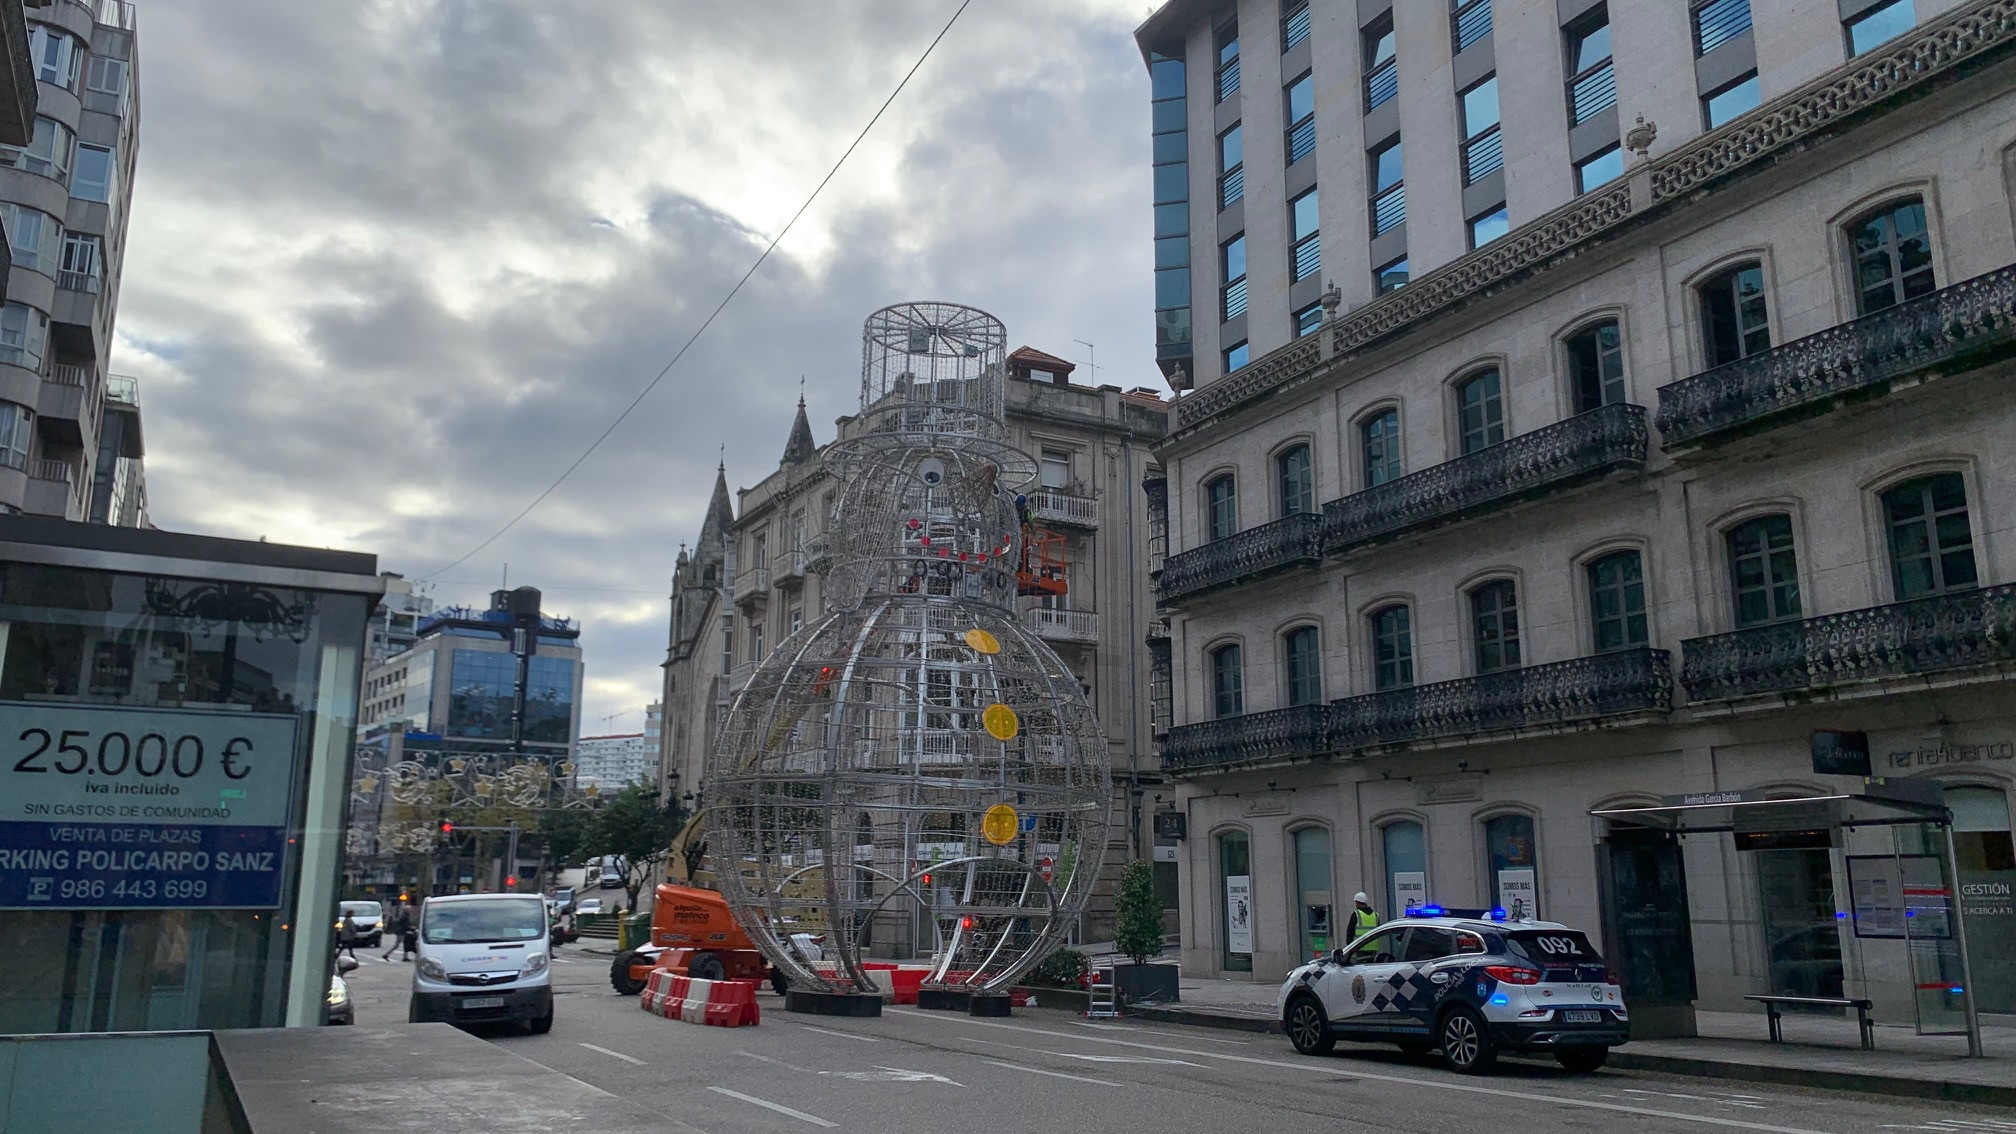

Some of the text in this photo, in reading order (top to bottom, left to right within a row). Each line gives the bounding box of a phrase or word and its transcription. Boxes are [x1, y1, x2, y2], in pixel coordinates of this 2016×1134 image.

[12, 727, 254, 780] 25.000 €
[85, 780, 180, 797] iva incluido
[1684, 795, 1704, 805] Avenida
[24, 803, 231, 819] SIN GASTOS DE COMUNIDAD
[1164, 818, 1178, 829] 24
[50, 827, 202, 844] VENTA DE PLAZAS
[76, 850, 210, 871] POLICARPO
[215, 852, 274, 872] SANZ
[61, 879, 105, 899] 986
[112, 879, 157, 899] 443
[164, 879, 208, 899] 699
[1503, 882, 1519, 891] SOMOS
[1962, 882, 2010, 895] GESTIÓN
[1969, 907, 1998, 915] ACERCA
[1536, 936, 1583, 956] 092
